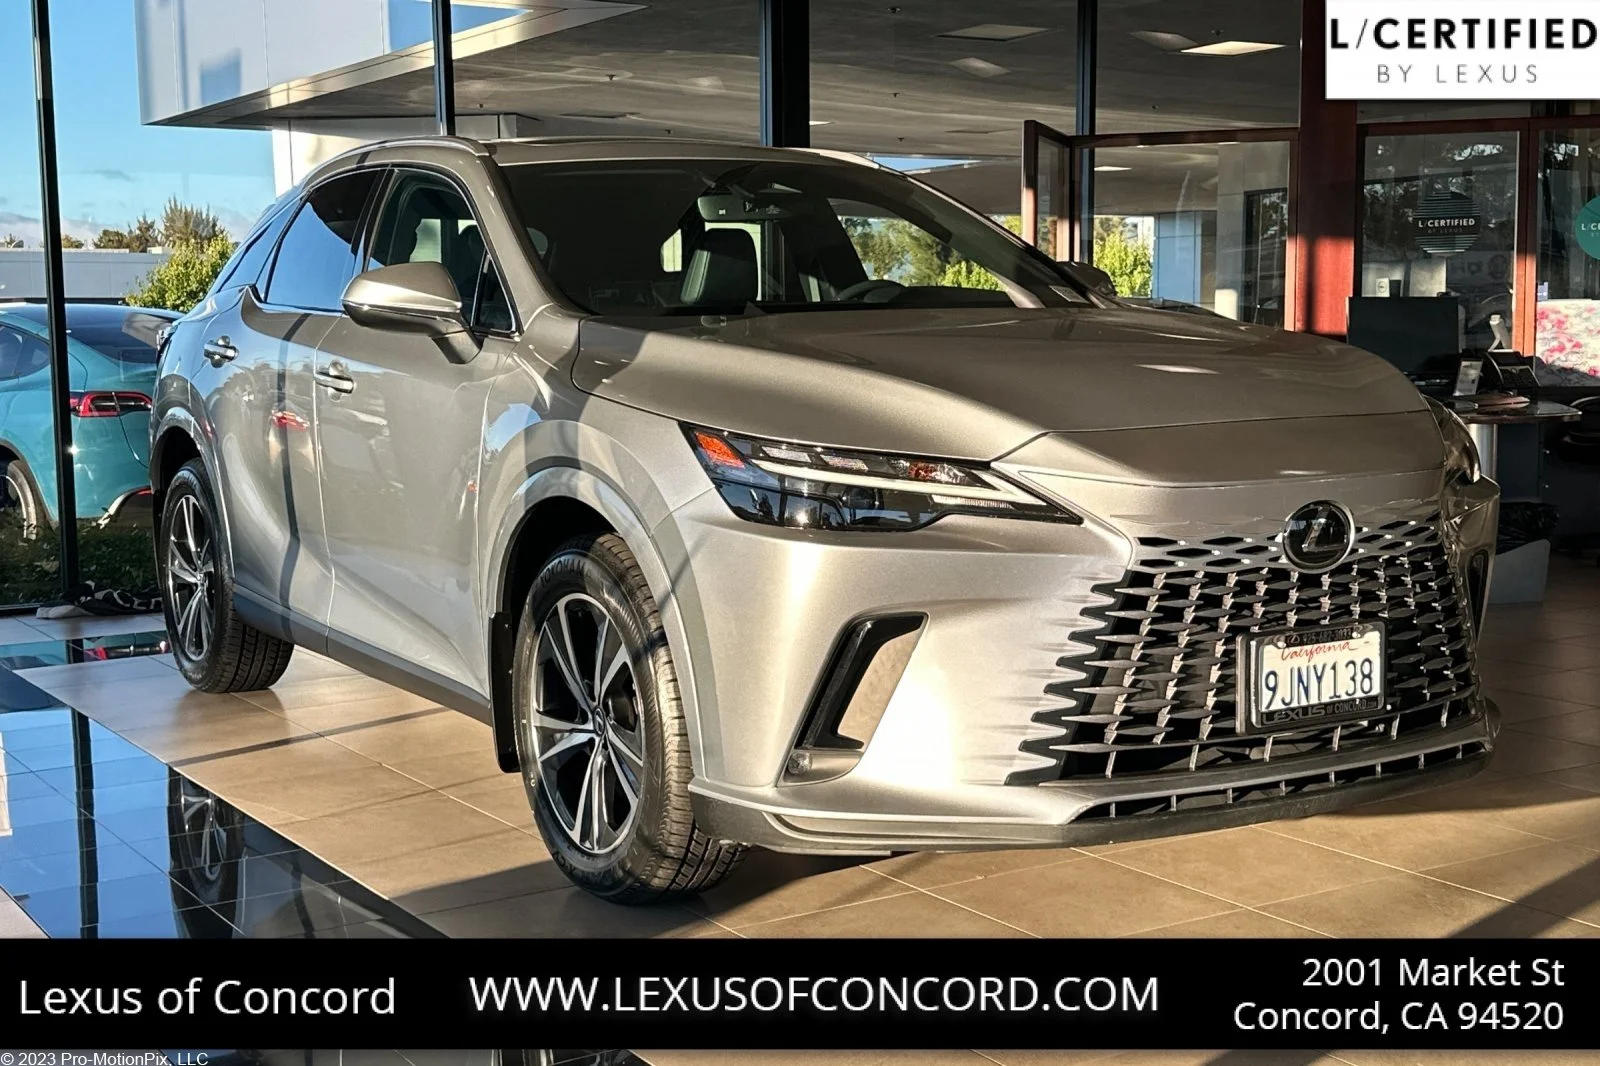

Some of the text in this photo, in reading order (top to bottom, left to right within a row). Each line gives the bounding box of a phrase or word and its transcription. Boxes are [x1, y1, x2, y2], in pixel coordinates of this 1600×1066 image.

[1418, 218, 1476, 228] L/CERTIFIED
[1280, 641, 1358, 663] California
[1264, 657, 1374, 710] 9JNY138
[1262, 705, 1326, 725] LEXUS
